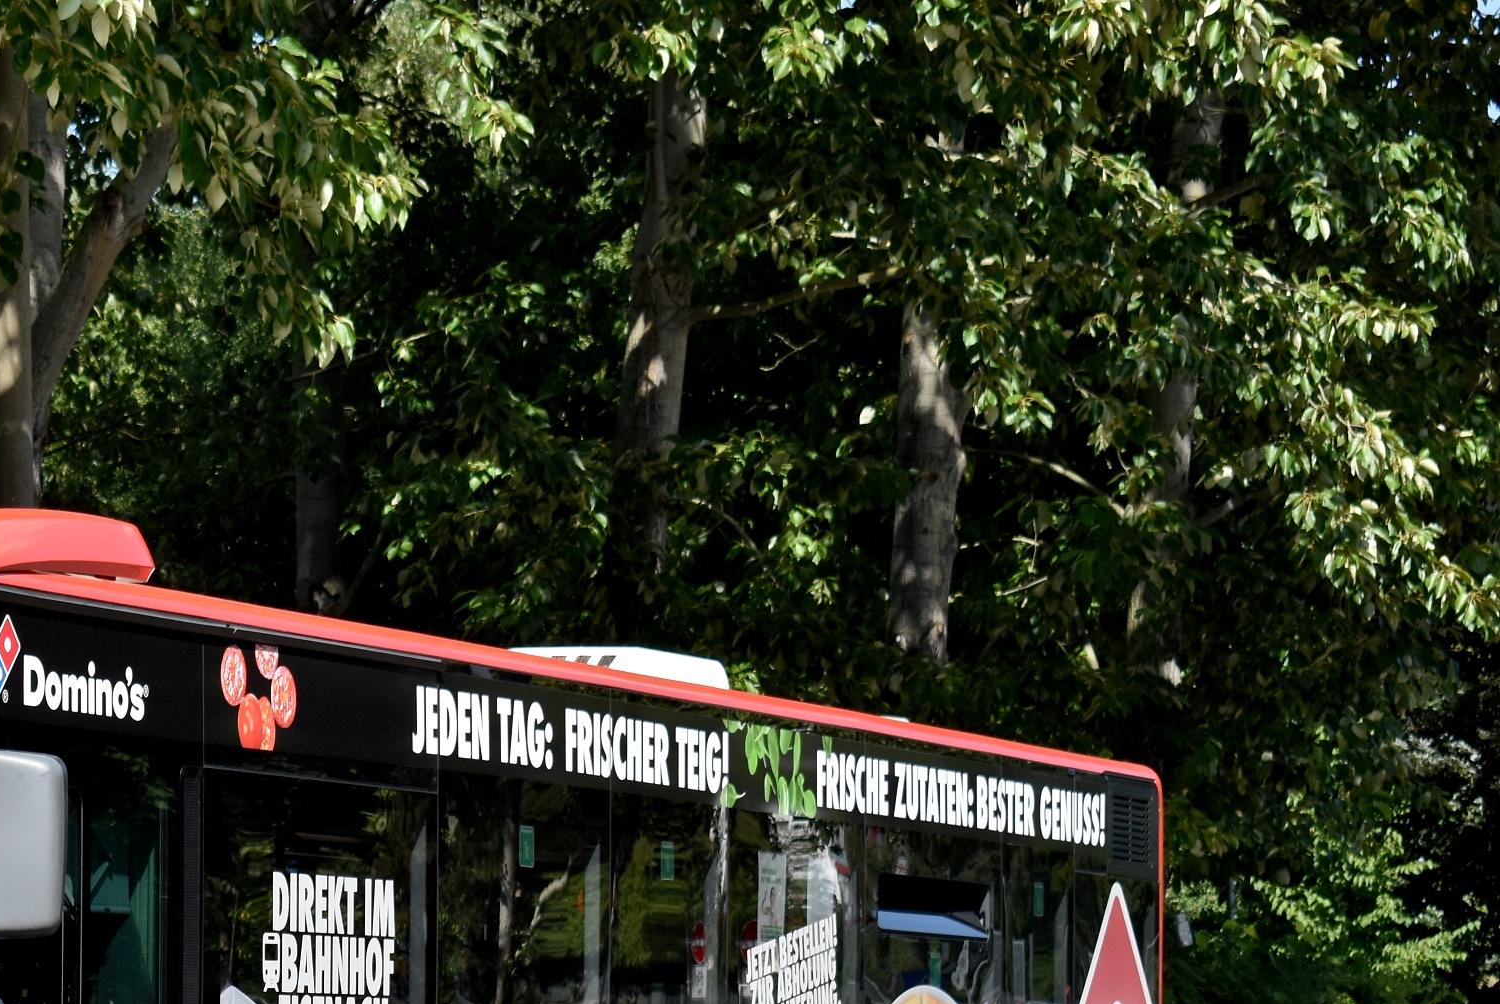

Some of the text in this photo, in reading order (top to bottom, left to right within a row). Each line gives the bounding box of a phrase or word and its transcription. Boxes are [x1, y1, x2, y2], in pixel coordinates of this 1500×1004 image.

[23, 654, 146, 722] Domino's
[412, 685, 730, 793] JEDEN TAG: FRISCHER TEIG!
[815, 748, 1107, 848] FRISCHE ZUTATEN: BESTER GENUSS!
[272, 871, 395, 938] DIREKT IM
[281, 933, 395, 997] BAHNHOF
[746, 939, 778, 984] JETZT
[778, 913, 838, 968] BESTELLEN!
[777, 948, 837, 1004] ABHOLUNG
